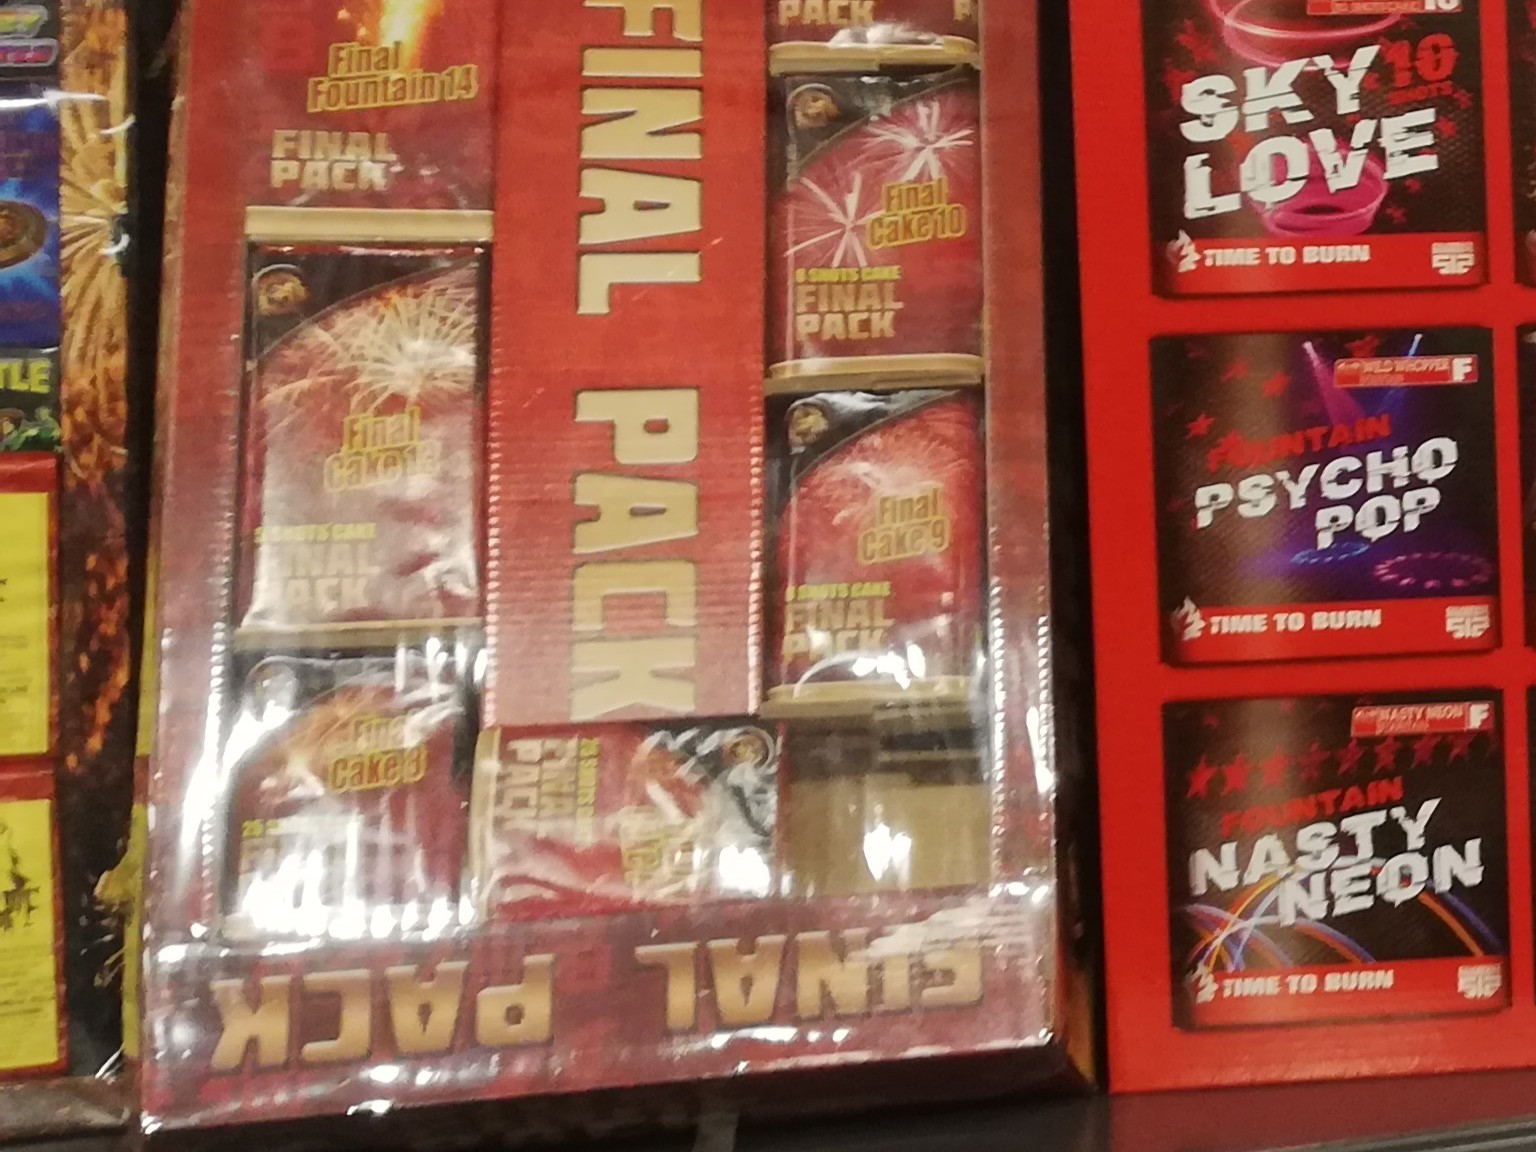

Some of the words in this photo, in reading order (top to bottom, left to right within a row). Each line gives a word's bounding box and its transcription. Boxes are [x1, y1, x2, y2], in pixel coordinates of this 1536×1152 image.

[307, 67, 444, 113] Fountain
[440, 63, 479, 100] 14
[328, 42, 405, 78] Final
[1179, 44, 1381, 143] SKY
[1182, 107, 1441, 219] LOVE
[1203, 248, 1260, 266] TIME
[1265, 247, 1296, 265] TO
[1301, 244, 1371, 263] BURN
[1194, 436, 1459, 528] PSYCHO
[1315, 486, 1441, 550] POP
[567, 387, 700, 724] PACK
[1189, 798, 1442, 896] NASTY
[1276, 839, 1485, 926] NEON
[209, 952, 557, 1075] PACK
